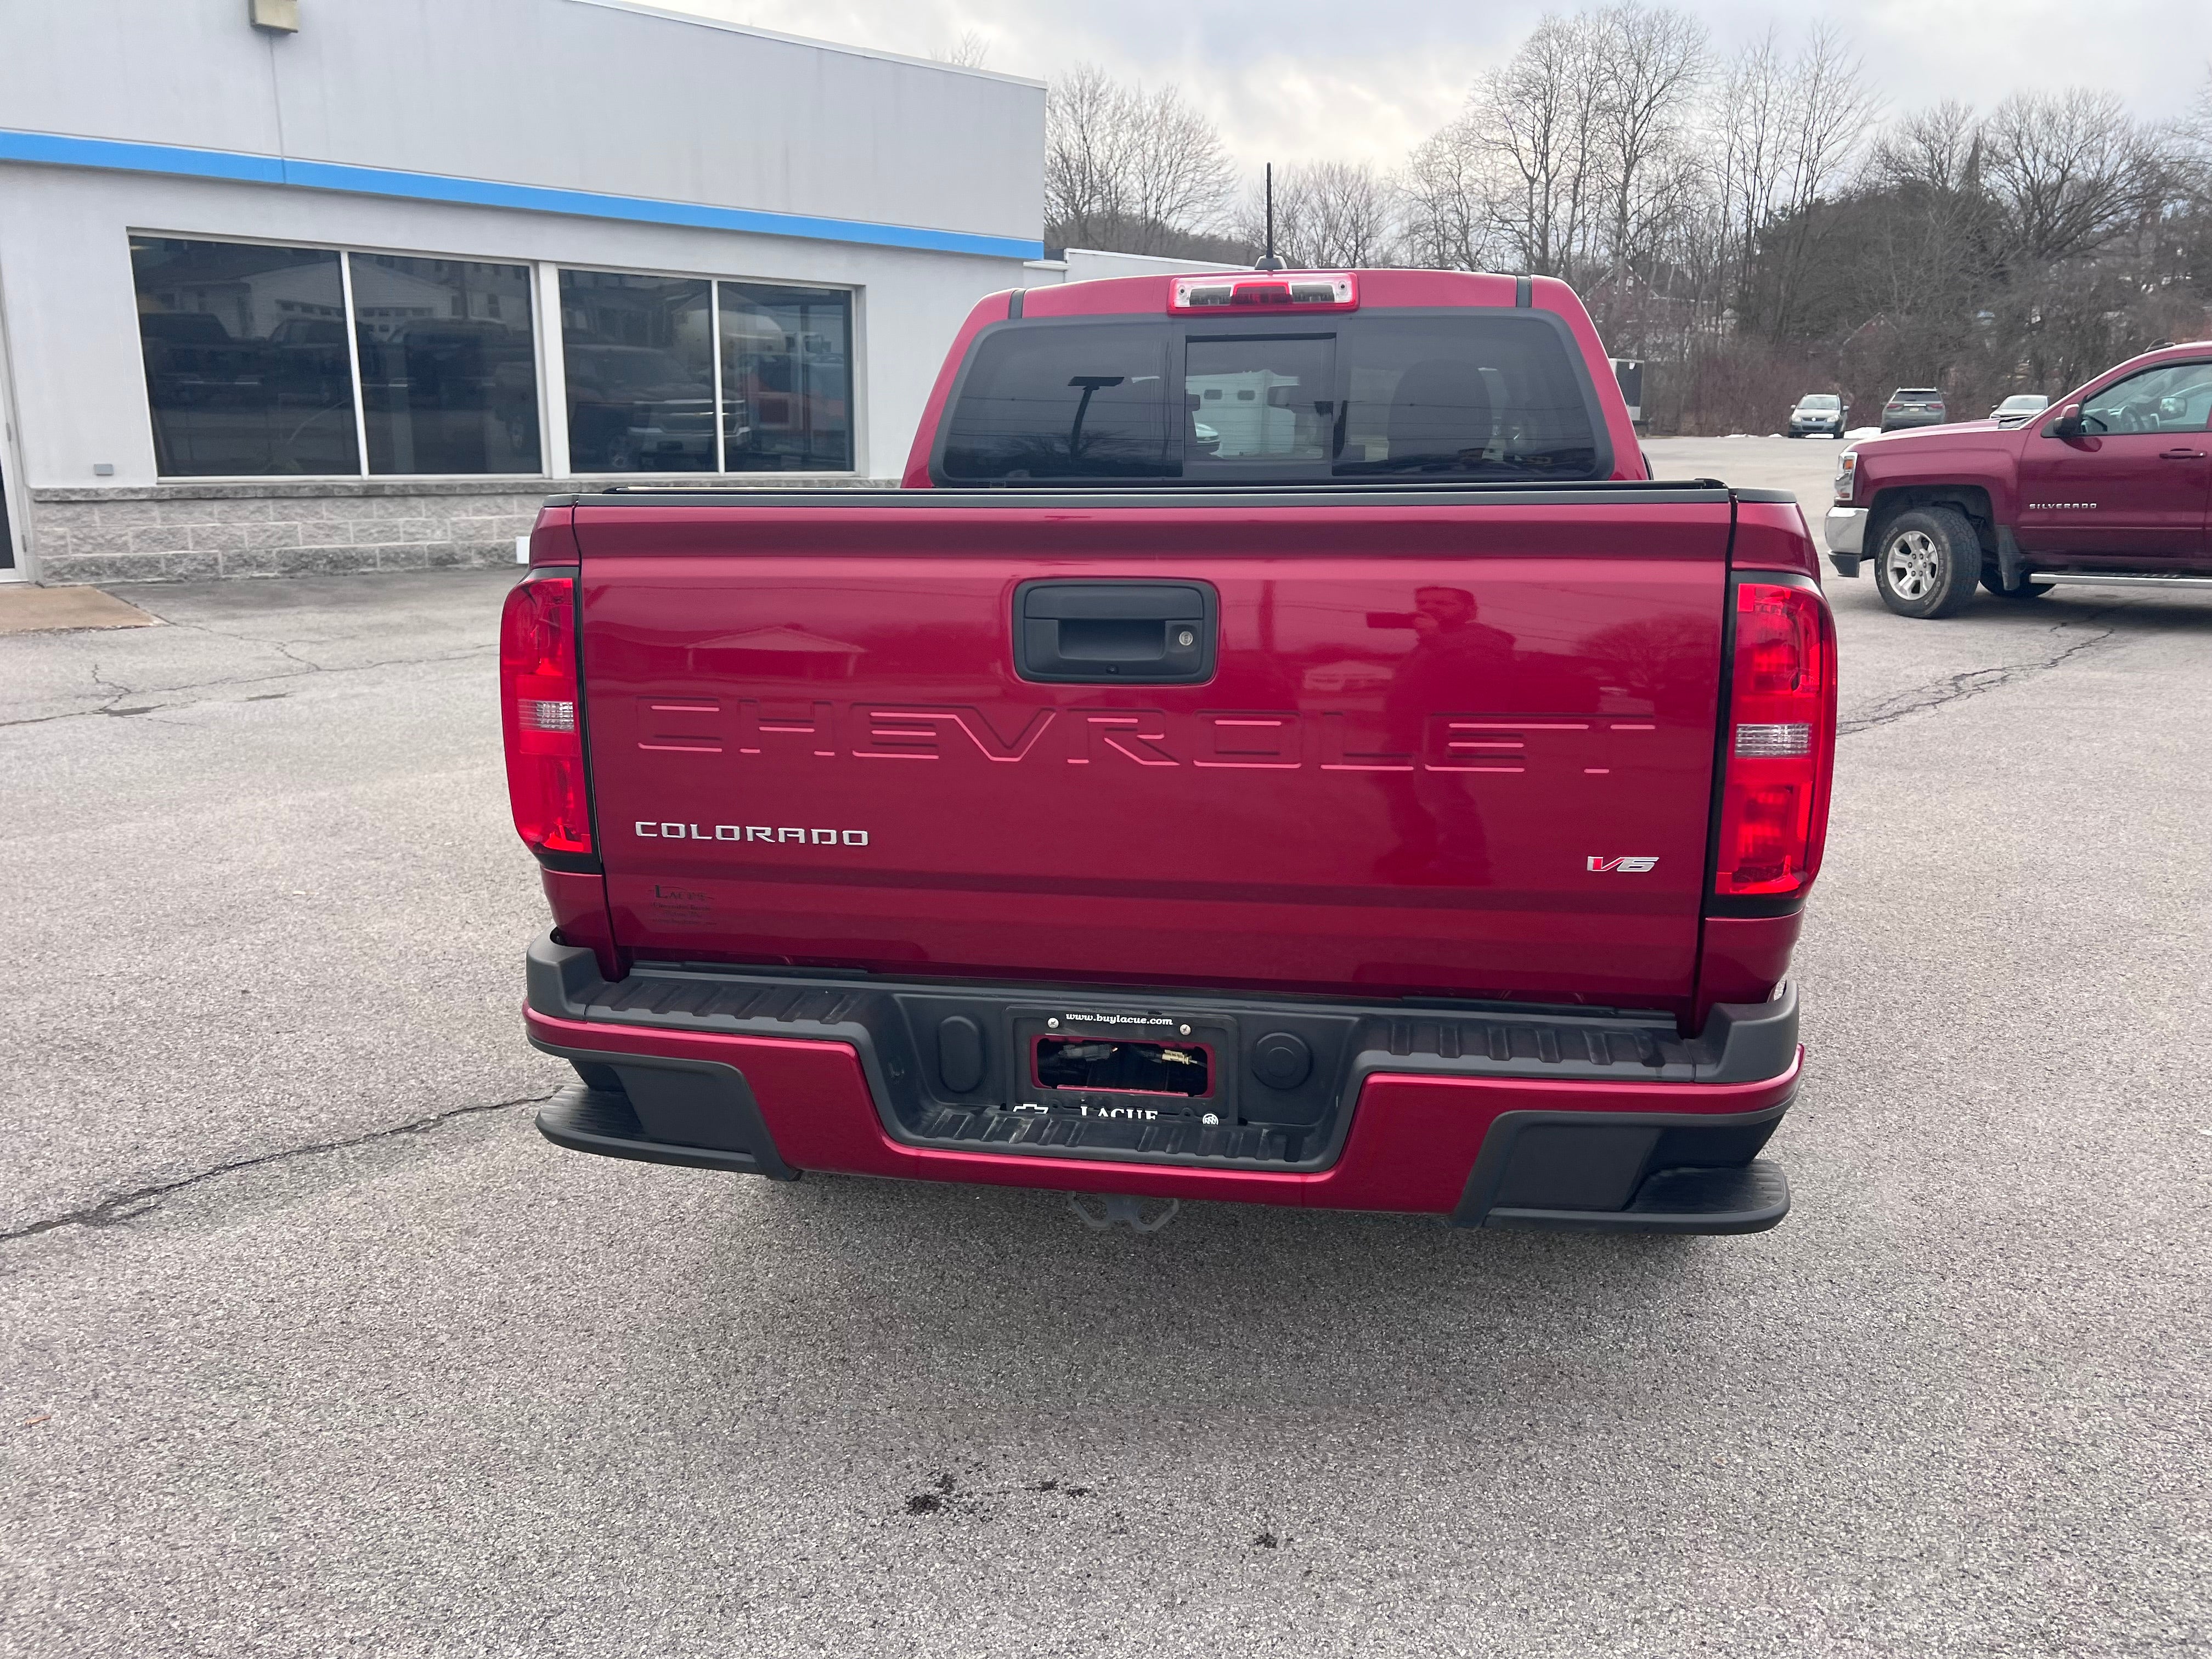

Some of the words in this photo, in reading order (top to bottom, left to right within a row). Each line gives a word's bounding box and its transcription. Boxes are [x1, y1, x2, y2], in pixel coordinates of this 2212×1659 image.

[635, 695, 1656, 774] CHEVROLET
[635, 821, 869, 847] COLORADO
[1587, 856, 1660, 872] V6
[1065, 1012, 1173, 1026] www.buylacue.com
